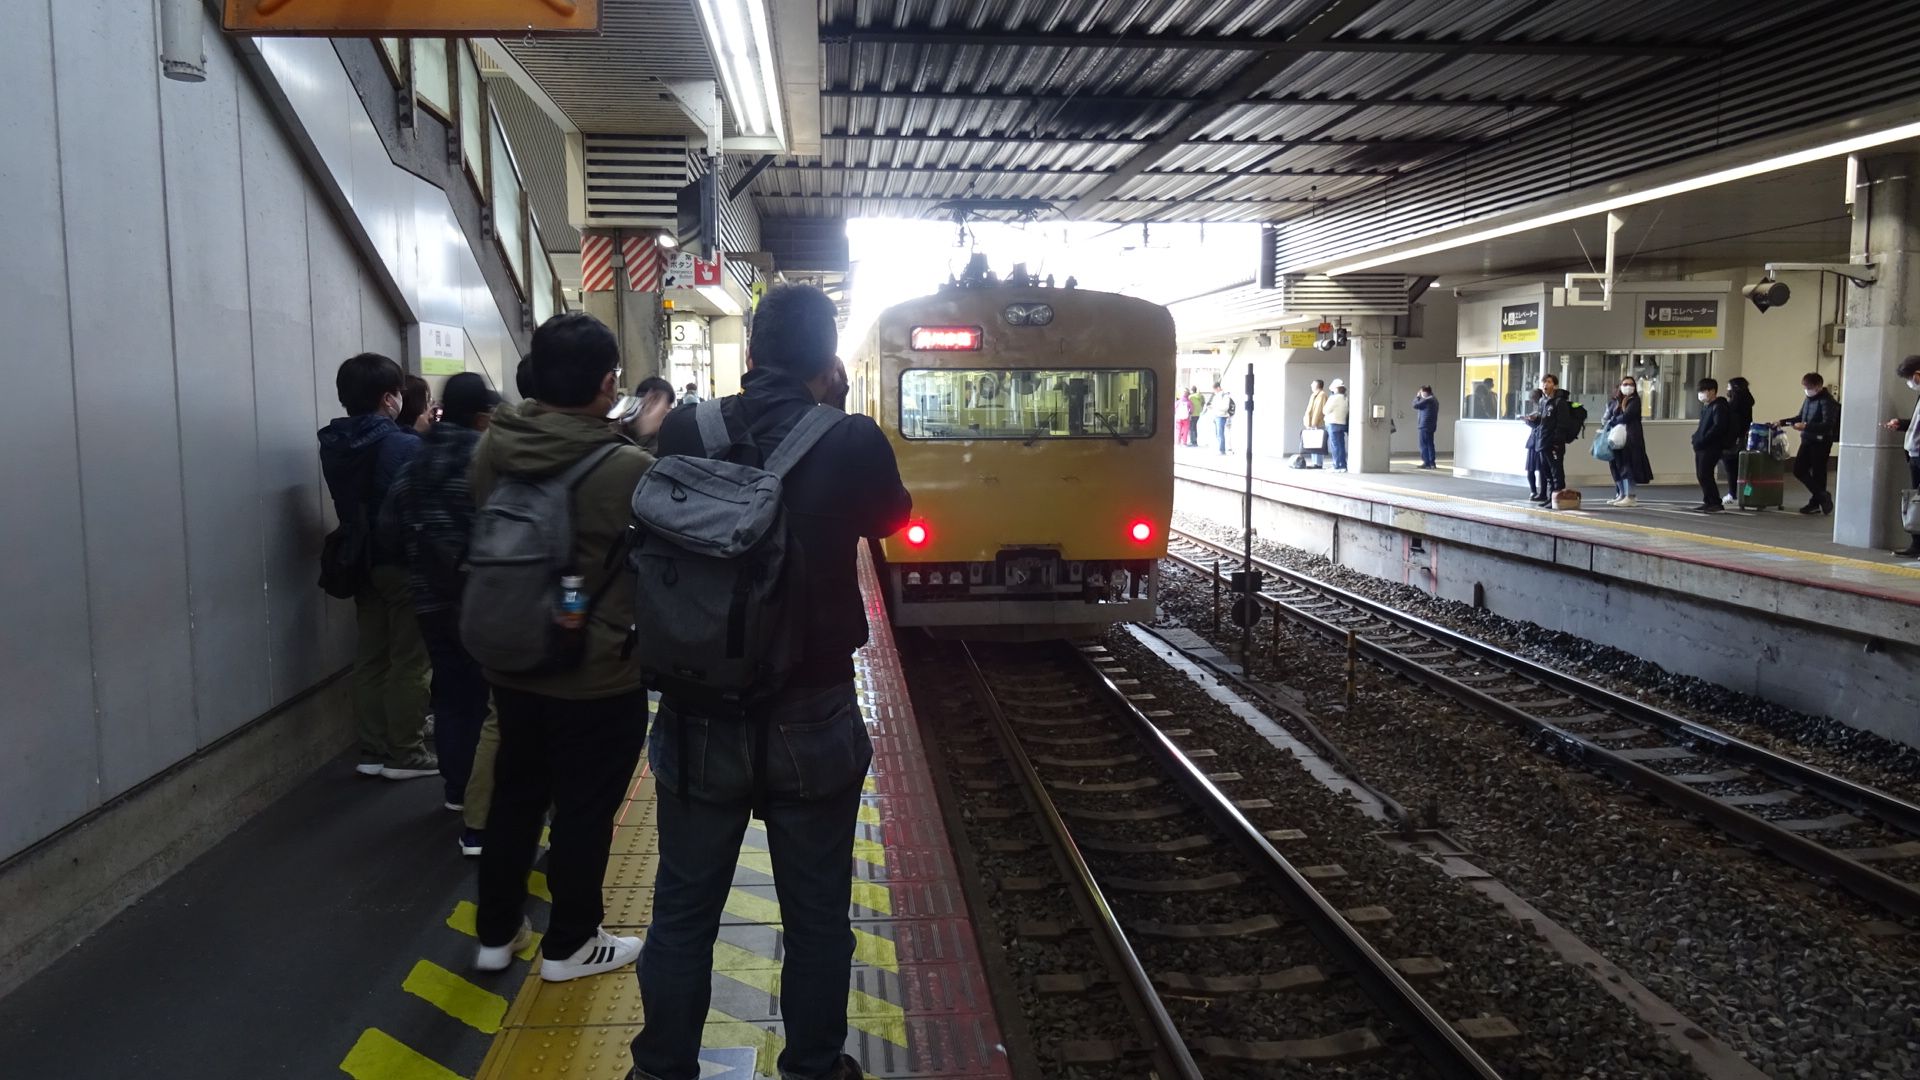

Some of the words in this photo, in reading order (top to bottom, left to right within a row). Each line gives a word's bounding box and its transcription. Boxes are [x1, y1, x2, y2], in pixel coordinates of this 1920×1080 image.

[670, 261, 693, 269] ボタン
[1514, 310, 1538, 319] エレベーター
[1672, 307, 1715, 315] エレベーター
[674, 325, 686, 342] 3
